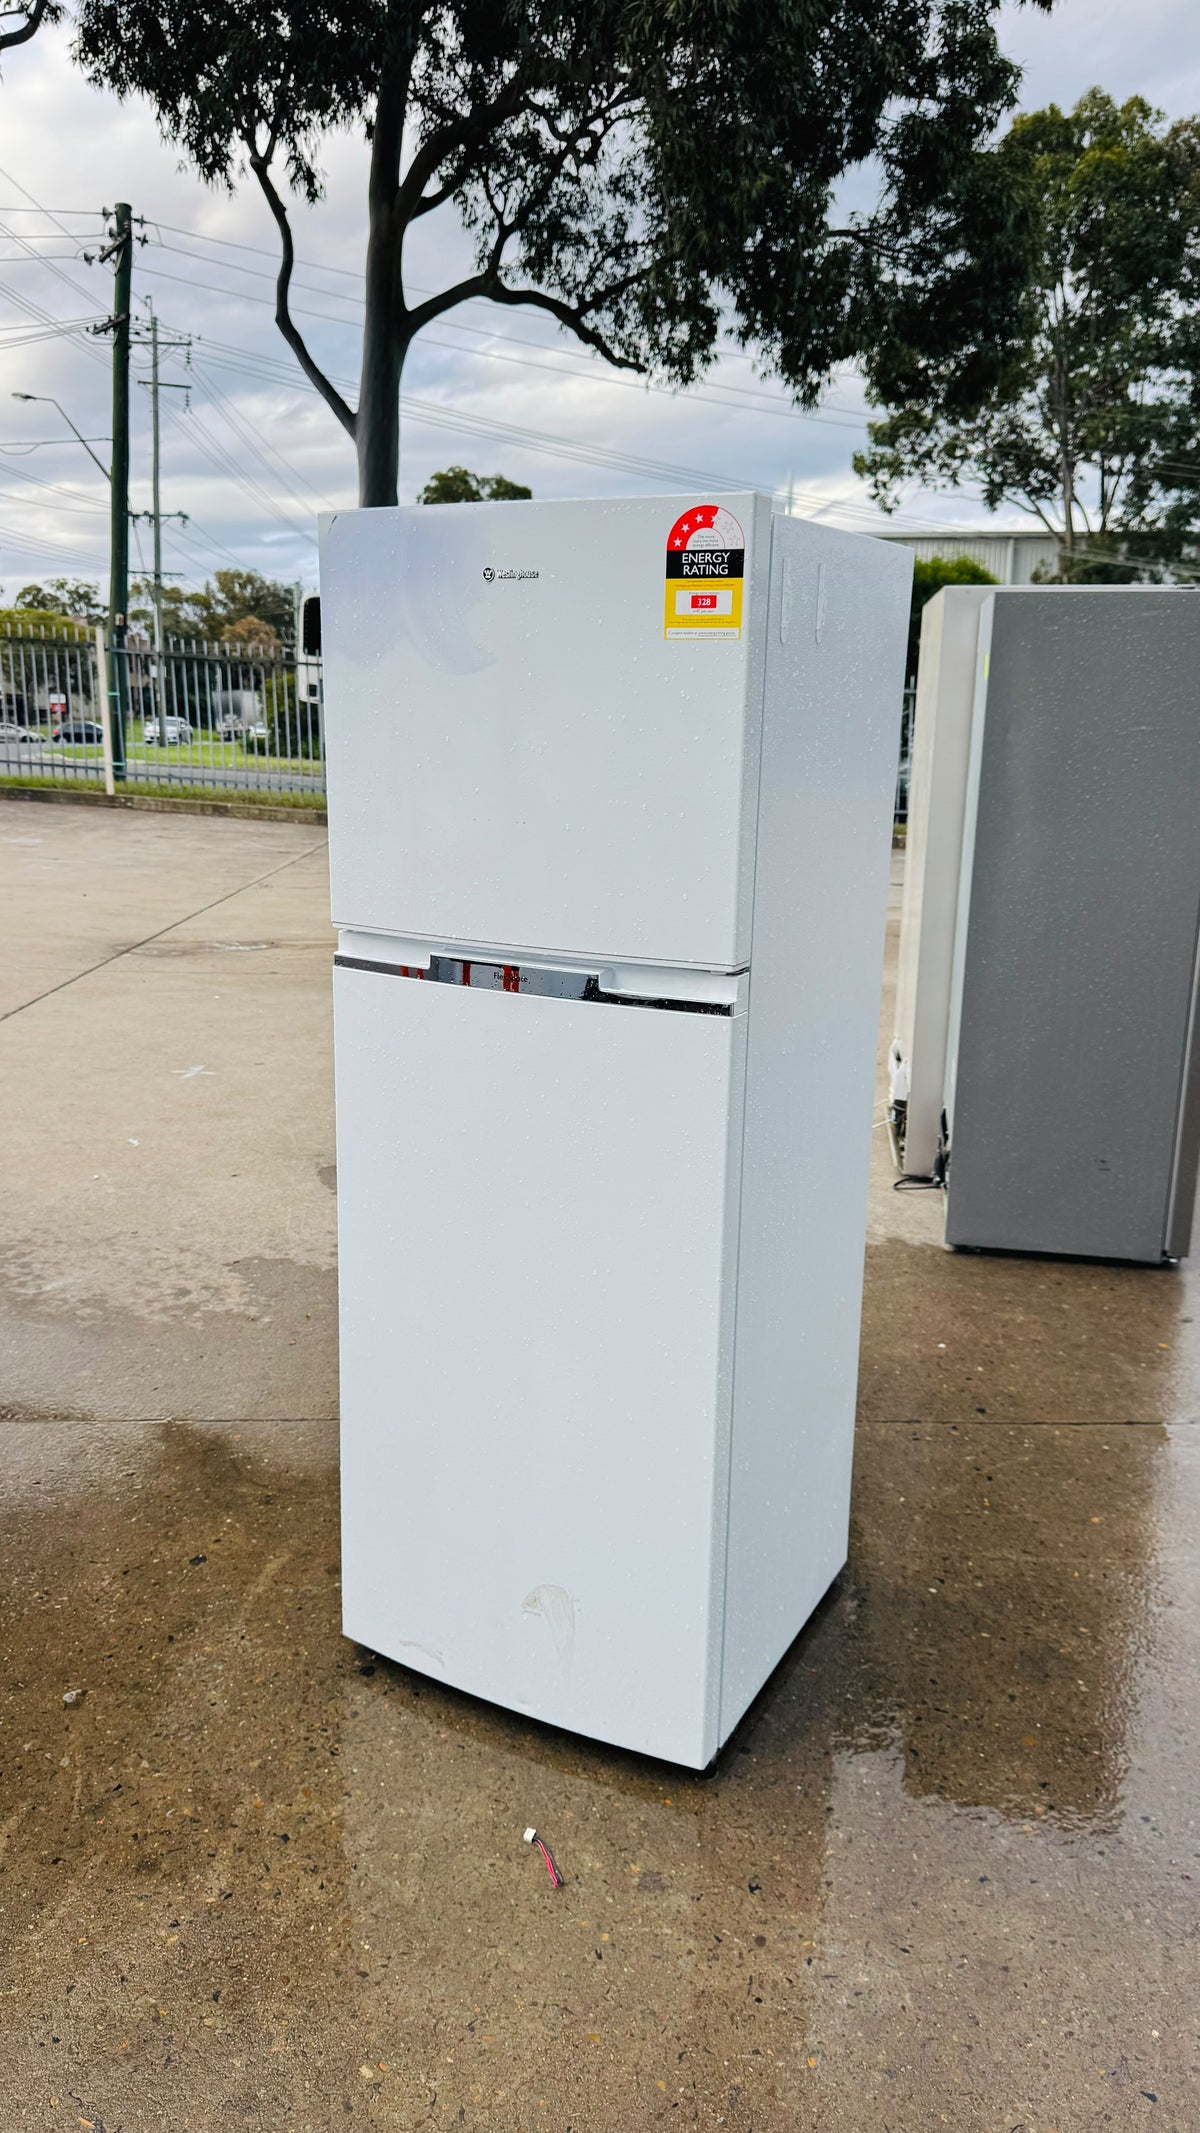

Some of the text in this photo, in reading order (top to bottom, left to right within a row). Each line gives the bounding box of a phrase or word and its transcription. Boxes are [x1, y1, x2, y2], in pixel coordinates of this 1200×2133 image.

[682, 552, 730, 563] ENERGY
[683, 564, 729, 576] RATING
[697, 598, 712, 606] 328
